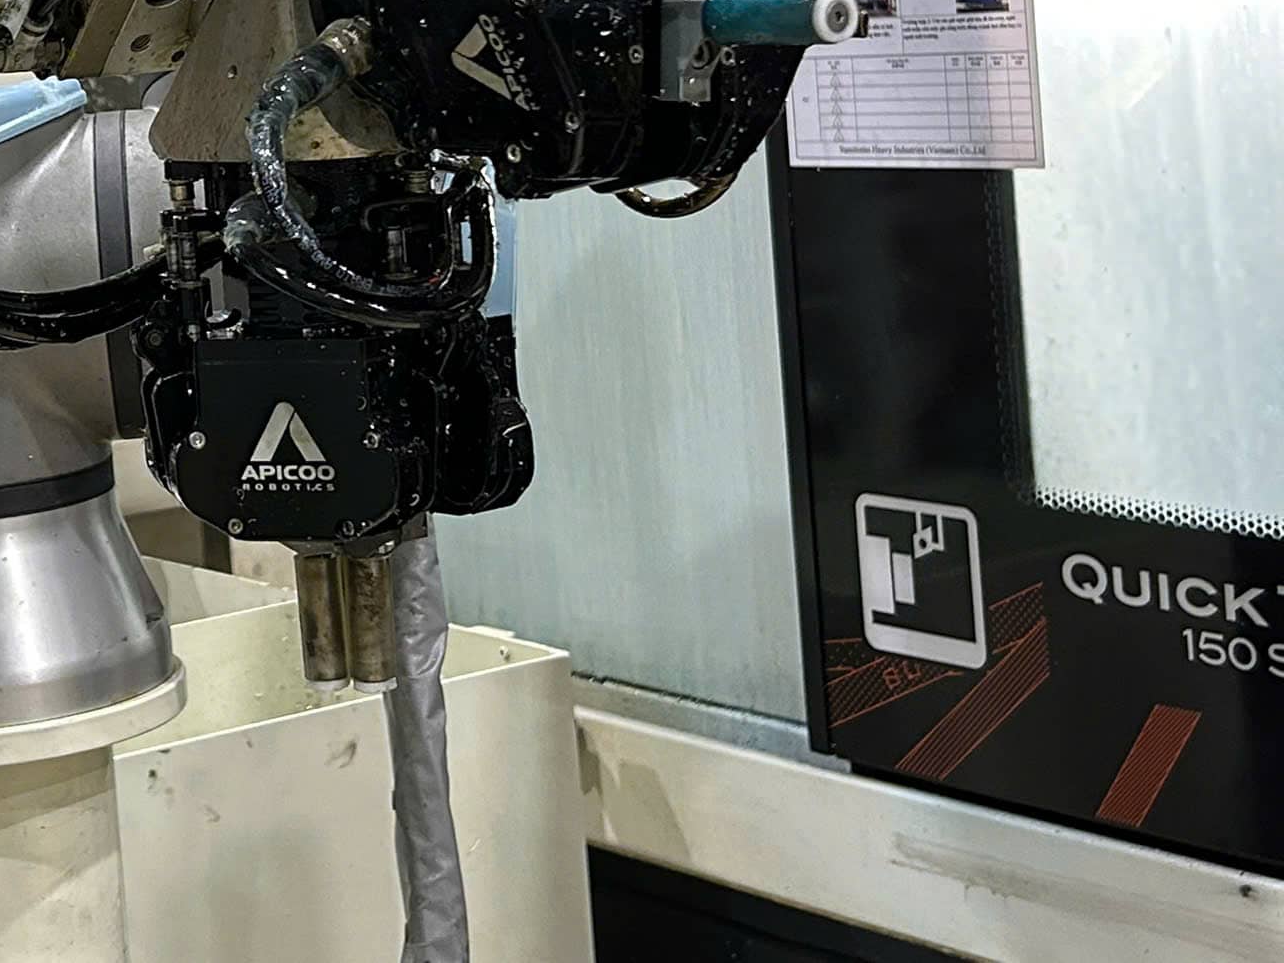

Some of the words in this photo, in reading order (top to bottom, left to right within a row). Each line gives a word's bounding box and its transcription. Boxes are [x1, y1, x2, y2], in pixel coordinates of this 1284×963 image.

[478, 14, 531, 111] APICOO
[241, 465, 336, 480] APICOO
[242, 483, 335, 491] ROBOTICS
[1061, 552, 1270, 628] QUICK
[1182, 628, 1257, 671] 150
